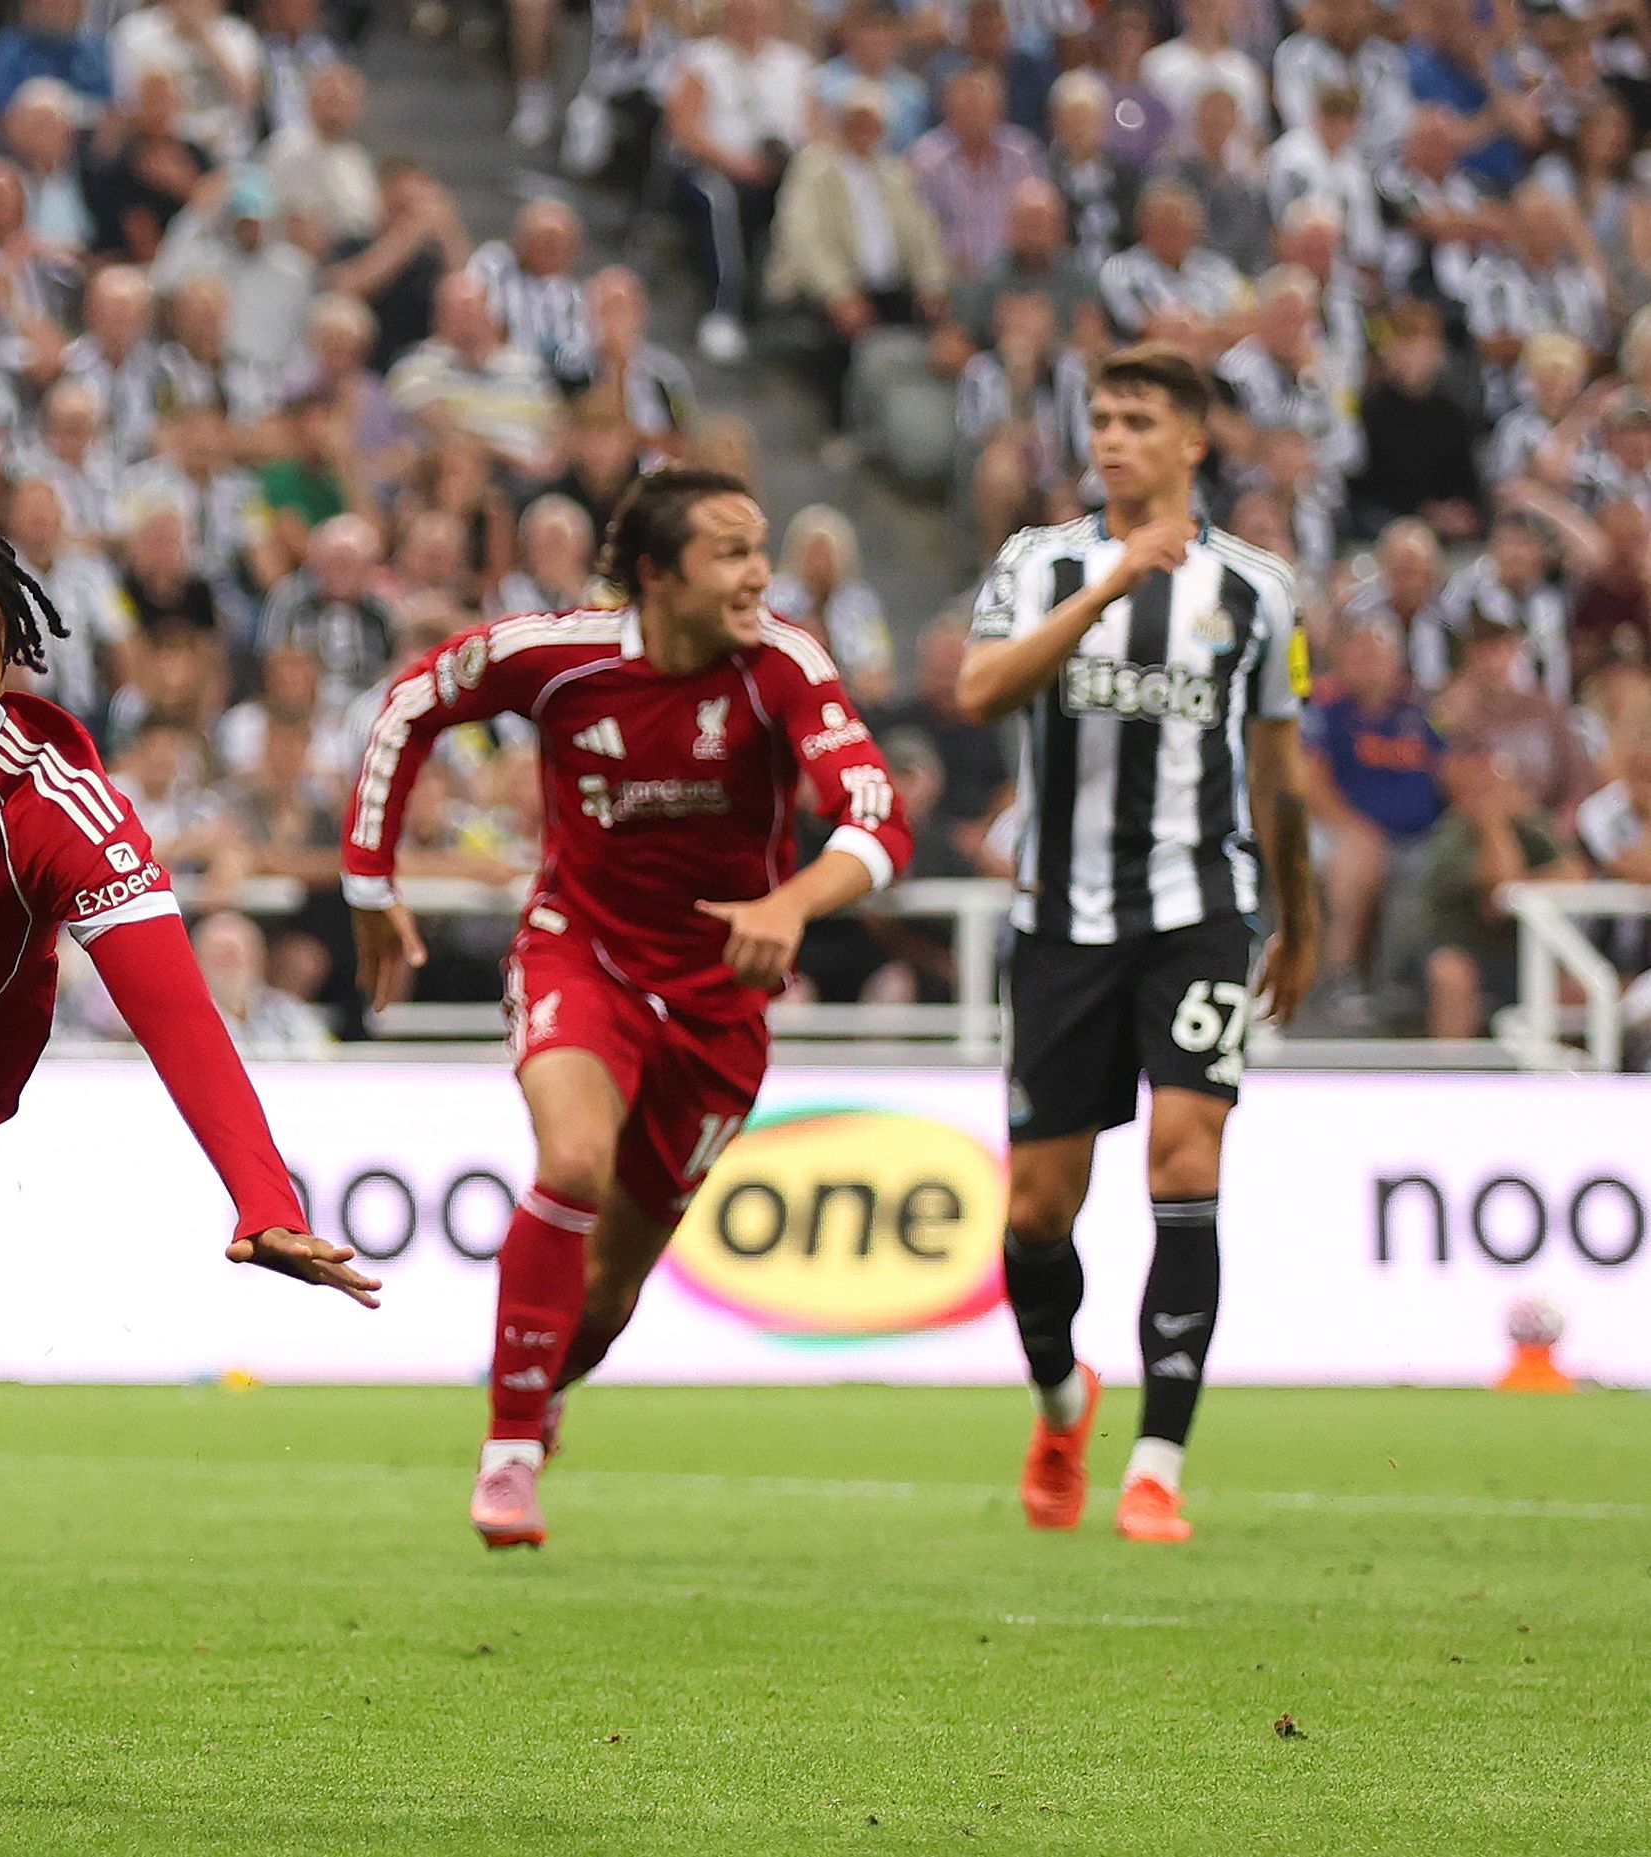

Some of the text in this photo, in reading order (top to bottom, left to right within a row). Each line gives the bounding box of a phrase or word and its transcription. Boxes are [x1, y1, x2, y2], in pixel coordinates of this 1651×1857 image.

[1170, 979, 1246, 1053] 67
[289, 1169, 962, 1261] oo one
